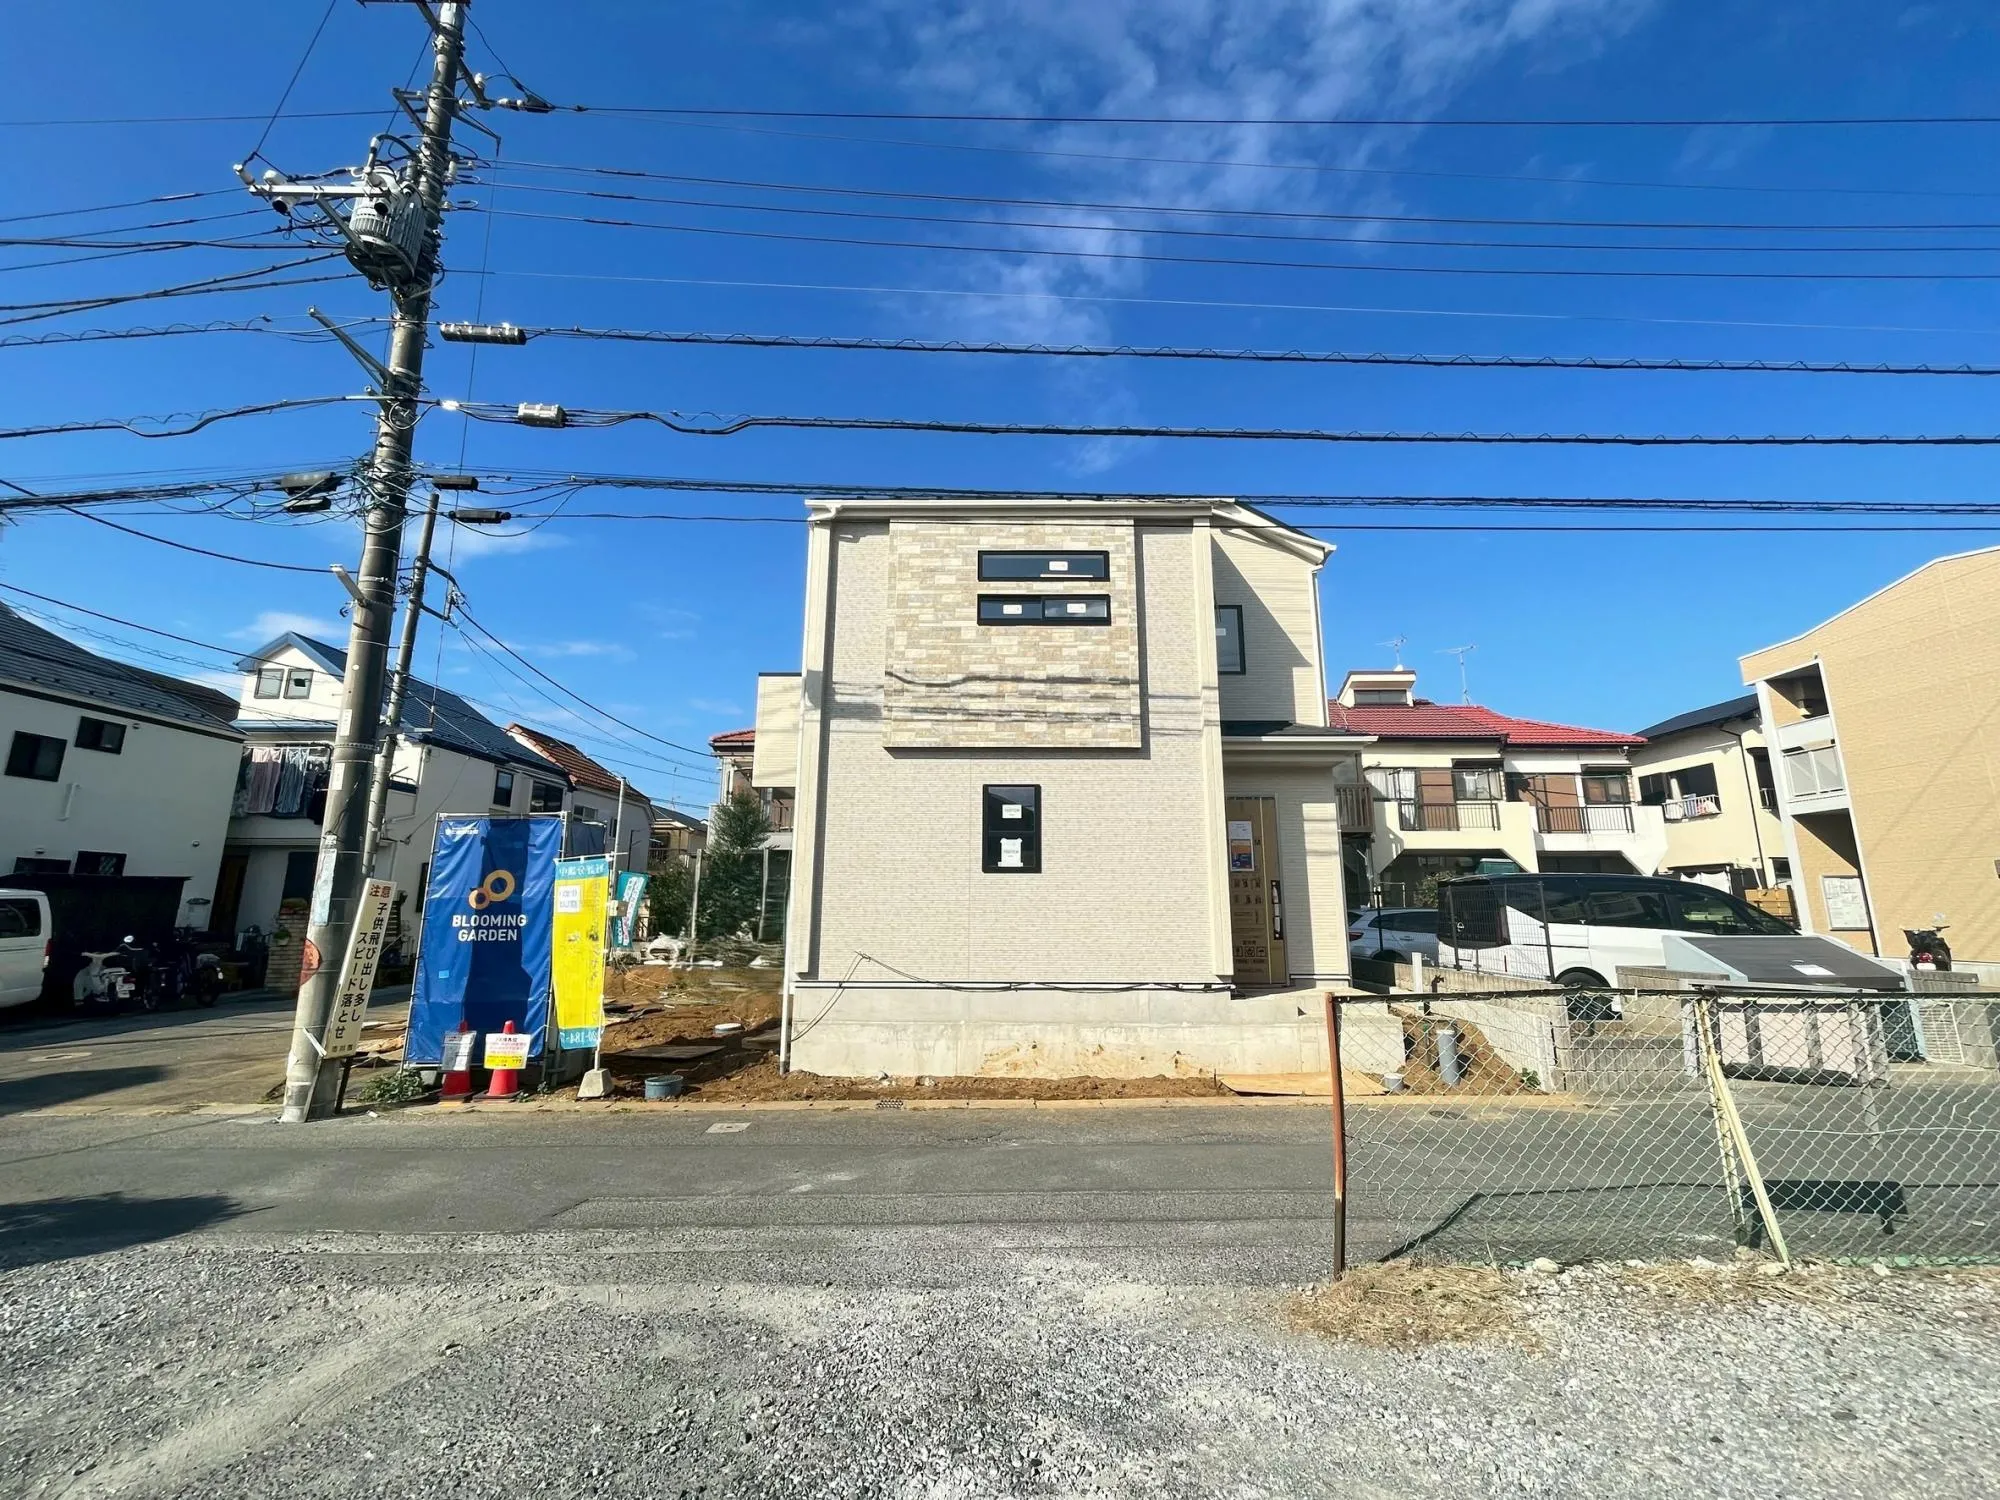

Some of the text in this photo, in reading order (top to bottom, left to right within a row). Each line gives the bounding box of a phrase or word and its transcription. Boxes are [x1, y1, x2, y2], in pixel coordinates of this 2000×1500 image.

[369, 884, 392, 899] 注意
[452, 914, 527, 927] BLOOMING
[458, 929, 518, 941] GARDEN
[351, 902, 388, 1022] 子供飛び出し多し
[335, 932, 367, 1039] スピード落とせ
